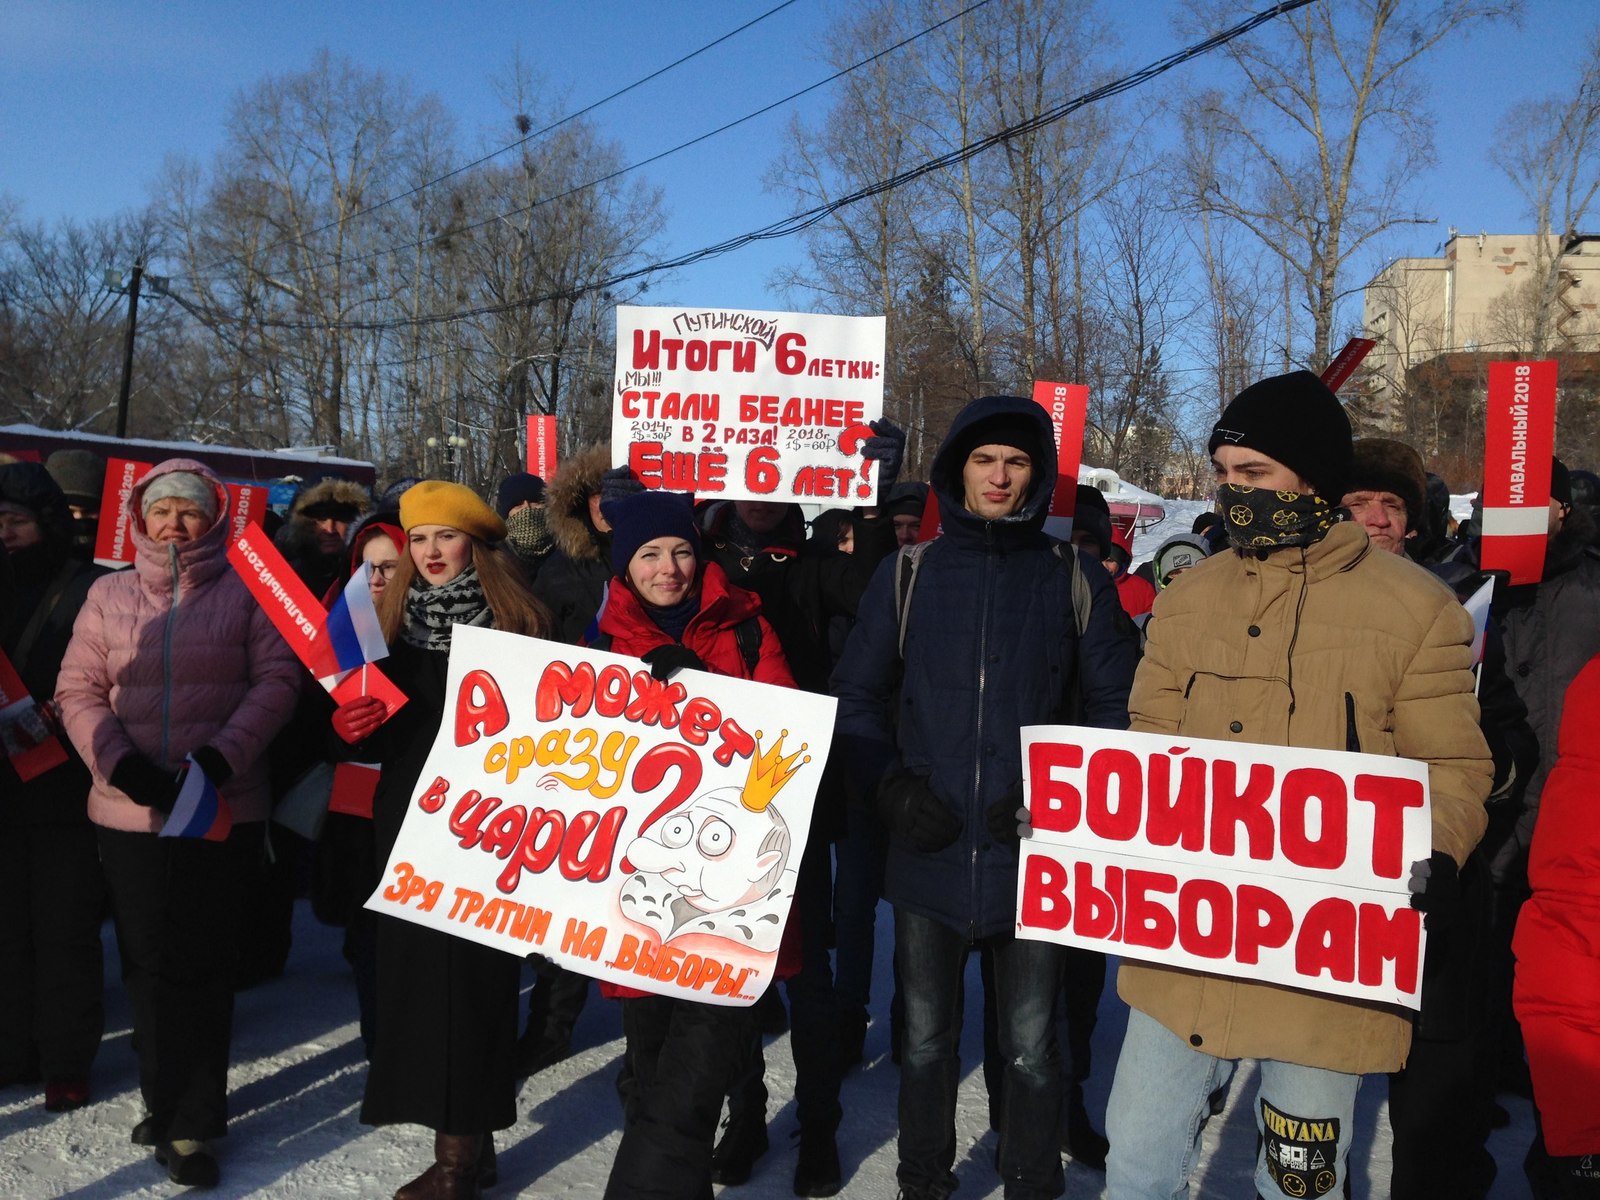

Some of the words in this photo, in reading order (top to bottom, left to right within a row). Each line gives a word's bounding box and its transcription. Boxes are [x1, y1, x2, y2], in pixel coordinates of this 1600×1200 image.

[673, 312, 778, 340] ПУТИНСКОЙ
[632, 329, 756, 373] ИТОГИ
[625, 371, 661, 387] МЫ!!!
[621, 391, 720, 421] СТАЛИ
[739, 394, 865, 428] БЕДНЕЕ
[682, 426, 694, 442] В
[702, 423, 716, 443] 2
[723, 425, 778, 446] РАЗА!
[629, 441, 728, 493] ЕЩЁ
[745, 446, 781, 494] 6
[258, 566, 318, 641] ВАЛЬНЫЙ
[454, 669, 510, 747] А
[484, 728, 640, 799] сразу
[418, 776, 450, 814] в
[1028, 742, 1424, 879] БОЙКОТ
[383, 862, 444, 912] ЗРЯ
[447, 887, 553, 946] ТРАТИМ
[560, 917, 608, 962] НА
[1021, 854, 1420, 995] ВЫБОРАМ
[1264, 1103, 1336, 1142] NIRVANA
